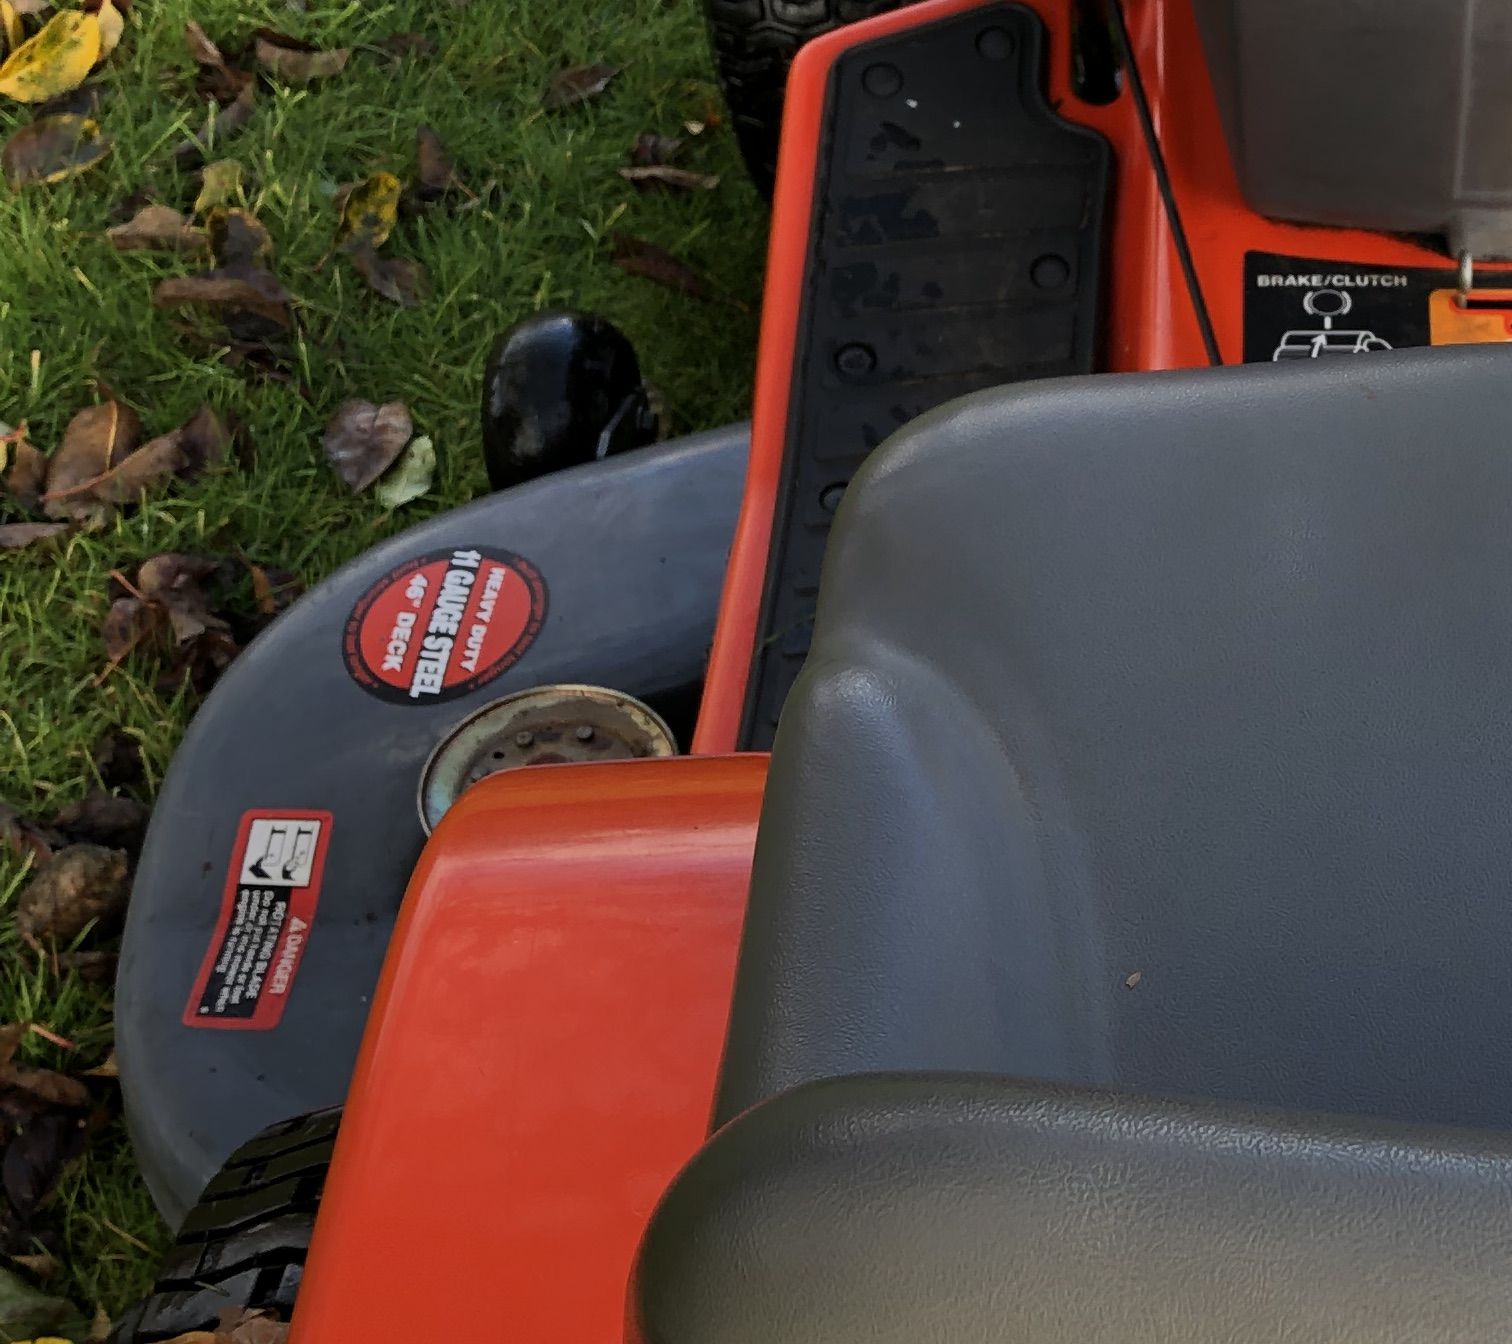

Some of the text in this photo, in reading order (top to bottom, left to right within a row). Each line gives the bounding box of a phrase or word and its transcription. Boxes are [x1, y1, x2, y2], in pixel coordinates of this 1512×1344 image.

[1256, 274, 1408, 287] BRAKE/CLUTCH
[428, 569, 475, 636] GAUGE
[476, 567, 506, 624] HEAVY
[381, 611, 417, 672] DECK
[409, 635, 454, 698] STEEL
[460, 623, 488, 673] DUTY
